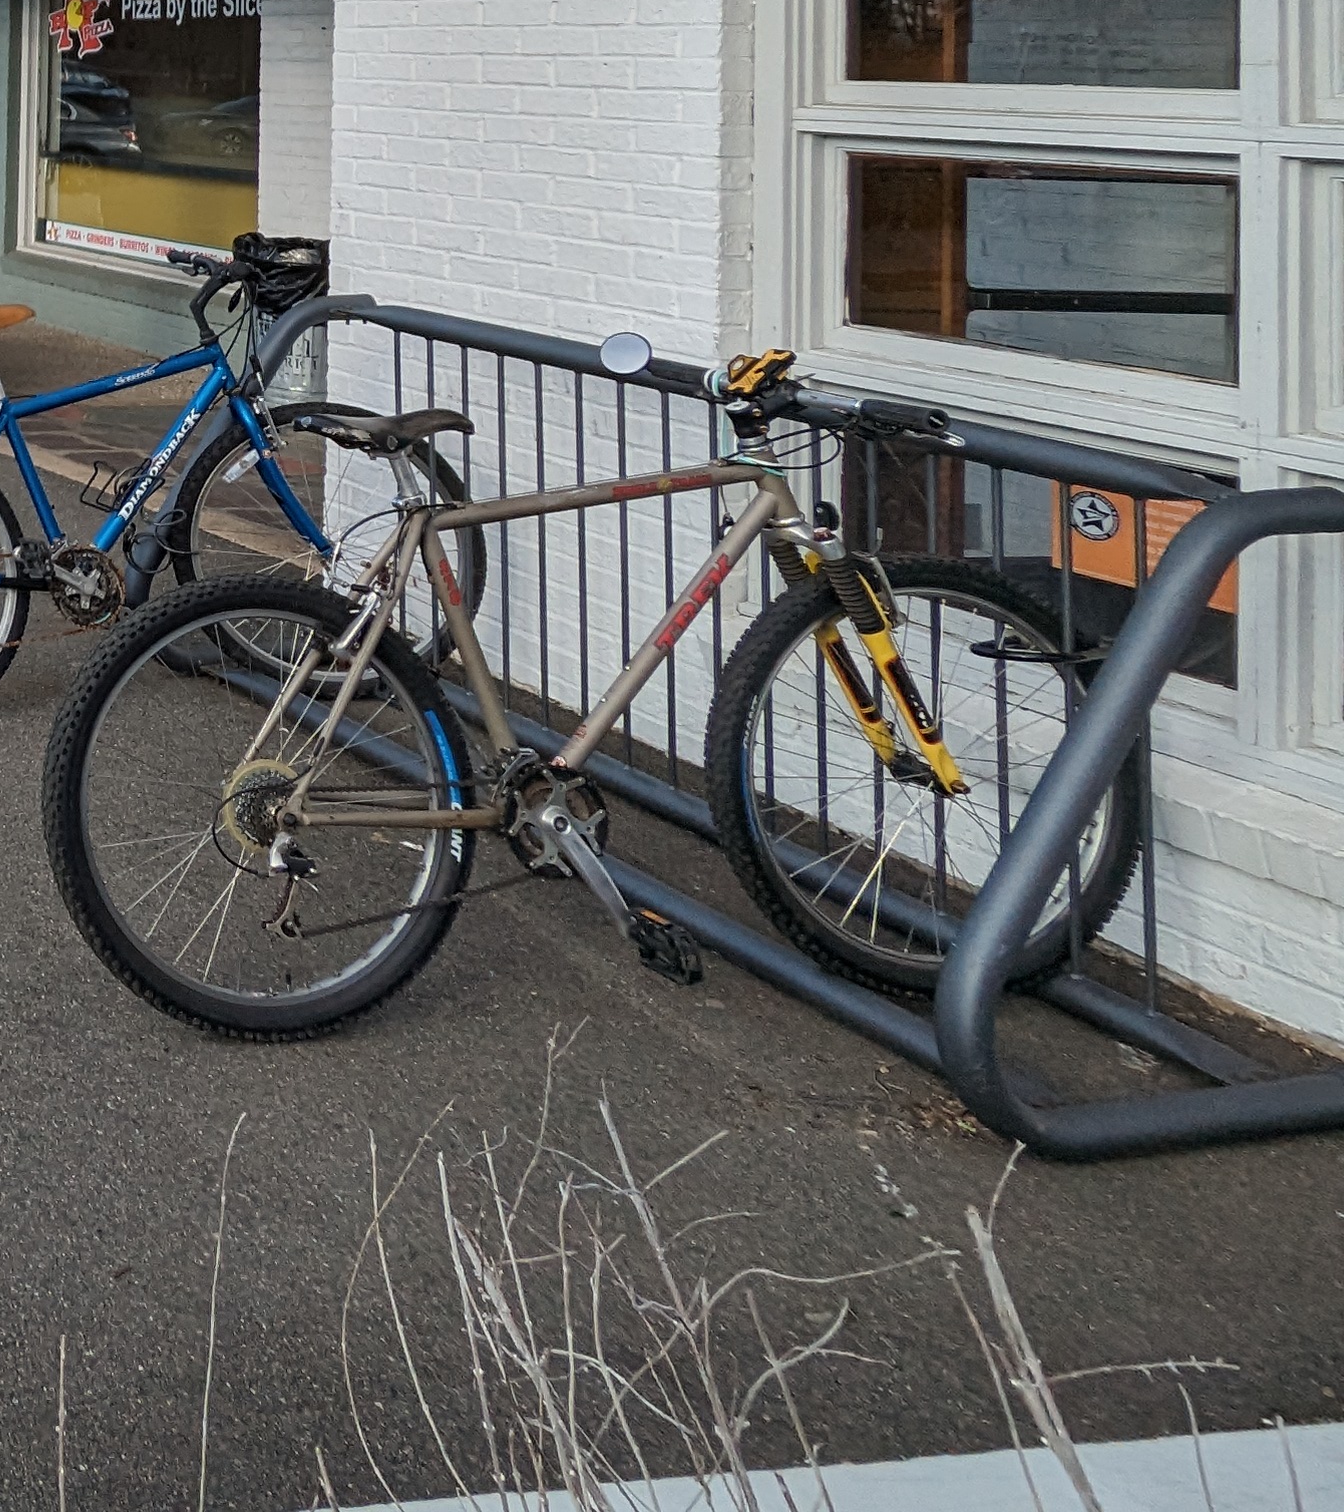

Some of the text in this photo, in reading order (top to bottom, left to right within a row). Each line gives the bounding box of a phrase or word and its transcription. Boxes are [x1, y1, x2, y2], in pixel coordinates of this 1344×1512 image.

[83, 19, 113, 40] PIZZA
[65, 228, 82, 241] PIZZA
[118, 408, 201, 520] DIAMONDBACK
[654, 553, 730, 650] TREK
